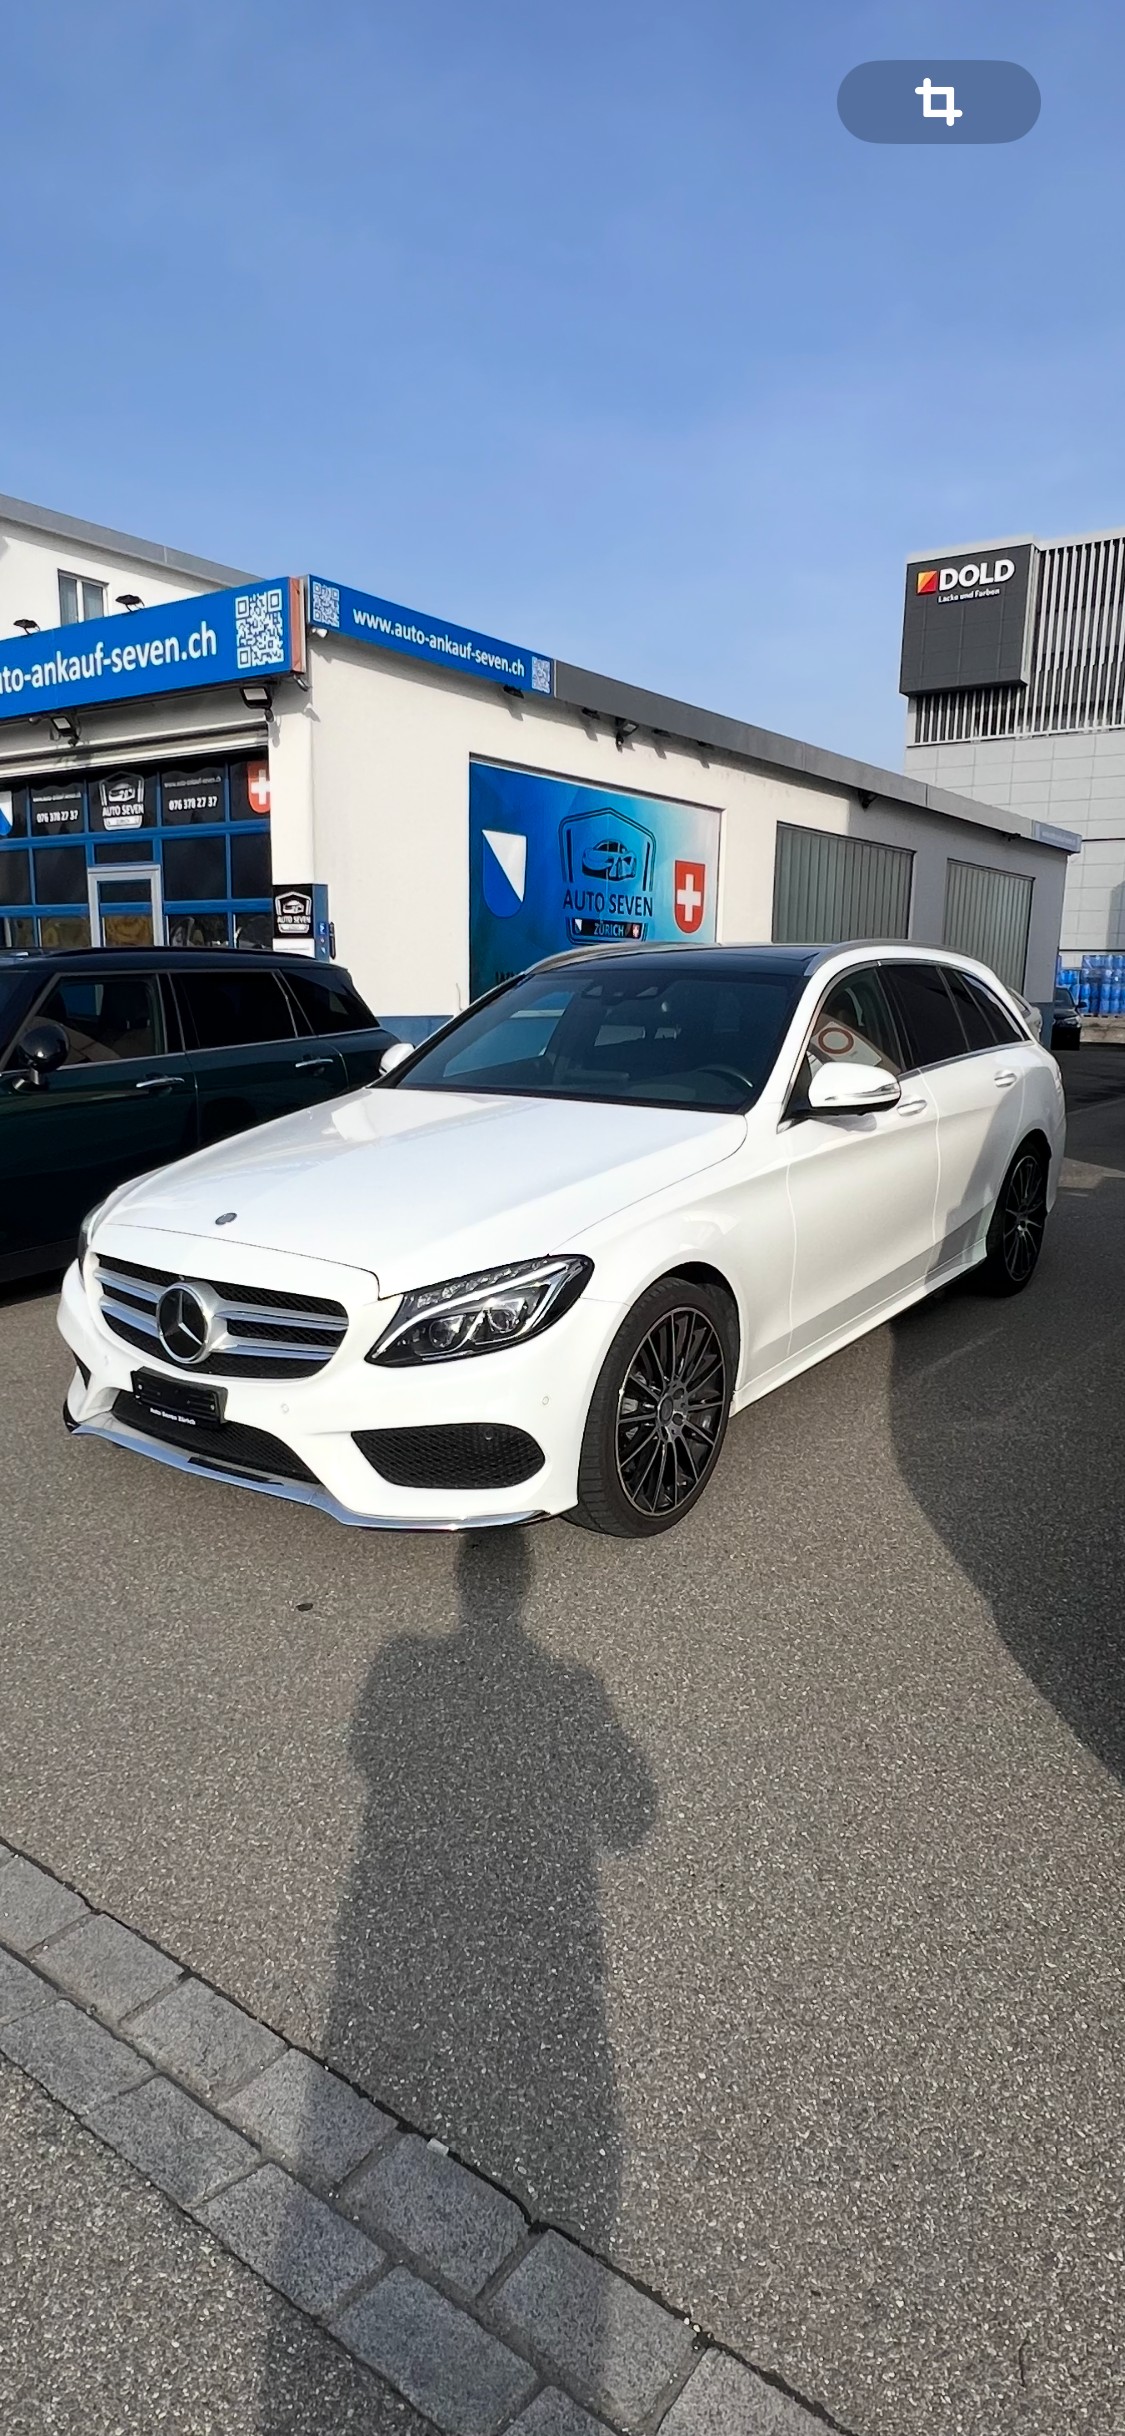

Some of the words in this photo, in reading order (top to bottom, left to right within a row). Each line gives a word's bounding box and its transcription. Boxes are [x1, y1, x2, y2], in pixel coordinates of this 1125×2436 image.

[939, 559, 1015, 591] DOLD
[960, 591, 974, 600] und
[353, 608, 525, 677] www.auto-ankauf-seven.ch
[0, 621, 217, 695] to-ankauf-seven.ch
[102, 805, 121, 816] AUTO
[122, 804, 144, 815] SEVEN
[169, 799, 182, 810] 076
[197, 797, 206, 808] 27
[208, 796, 218, 807] 37
[563, 889, 605, 912] AUTO
[608, 894, 653, 917] SEVEN
[594, 921, 624, 937] ZÜRICH
